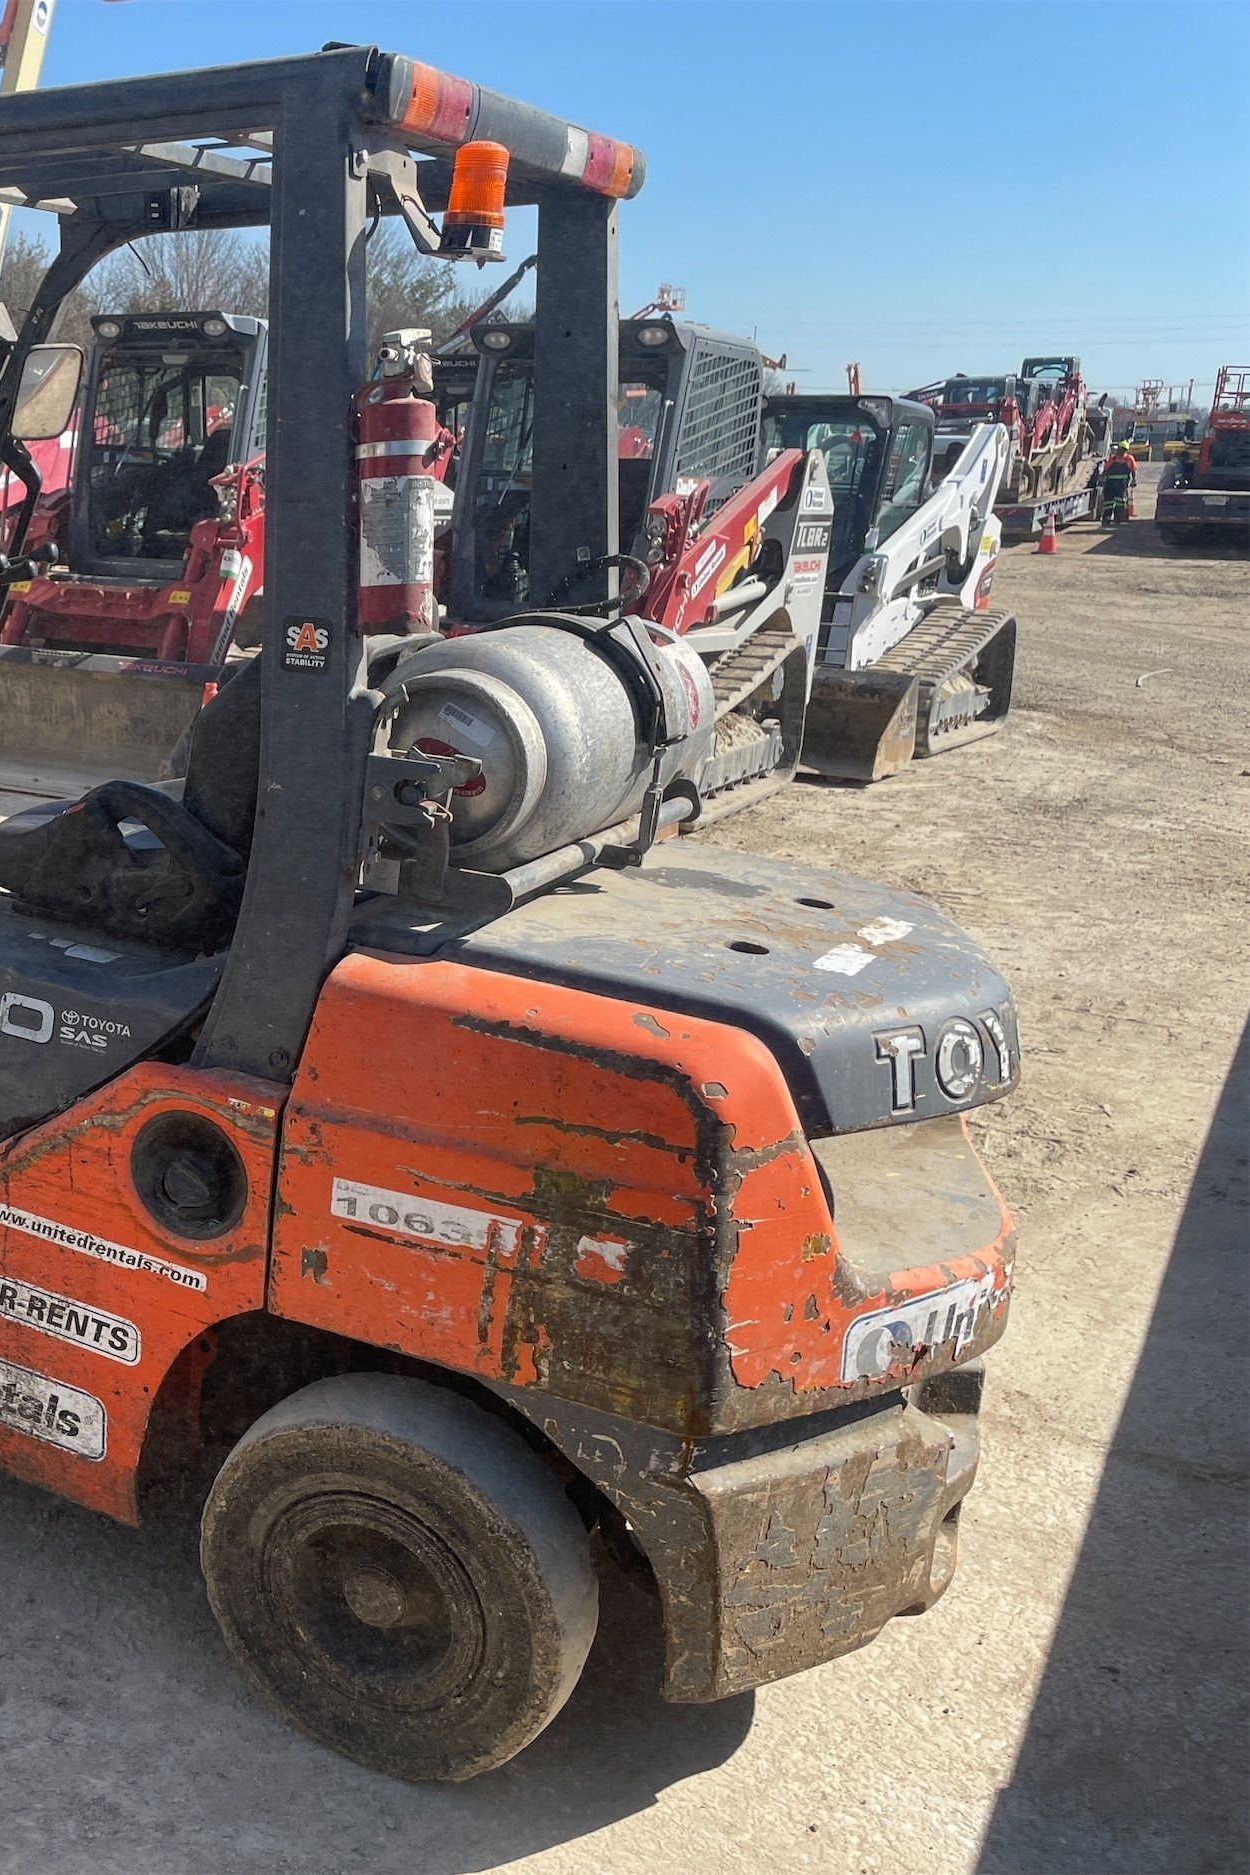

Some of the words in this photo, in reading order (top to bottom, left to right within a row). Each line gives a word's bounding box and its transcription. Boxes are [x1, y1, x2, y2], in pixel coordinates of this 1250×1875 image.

[133, 320, 198, 330] TAKEUCHI
[286, 622, 329, 652] SAS
[119, 661, 188, 675] TAKEUCHI
[285, 658, 326, 668] STABILITY
[81, 1014, 131, 1038] TOYOTA
[60, 1026, 108, 1048] SAS
